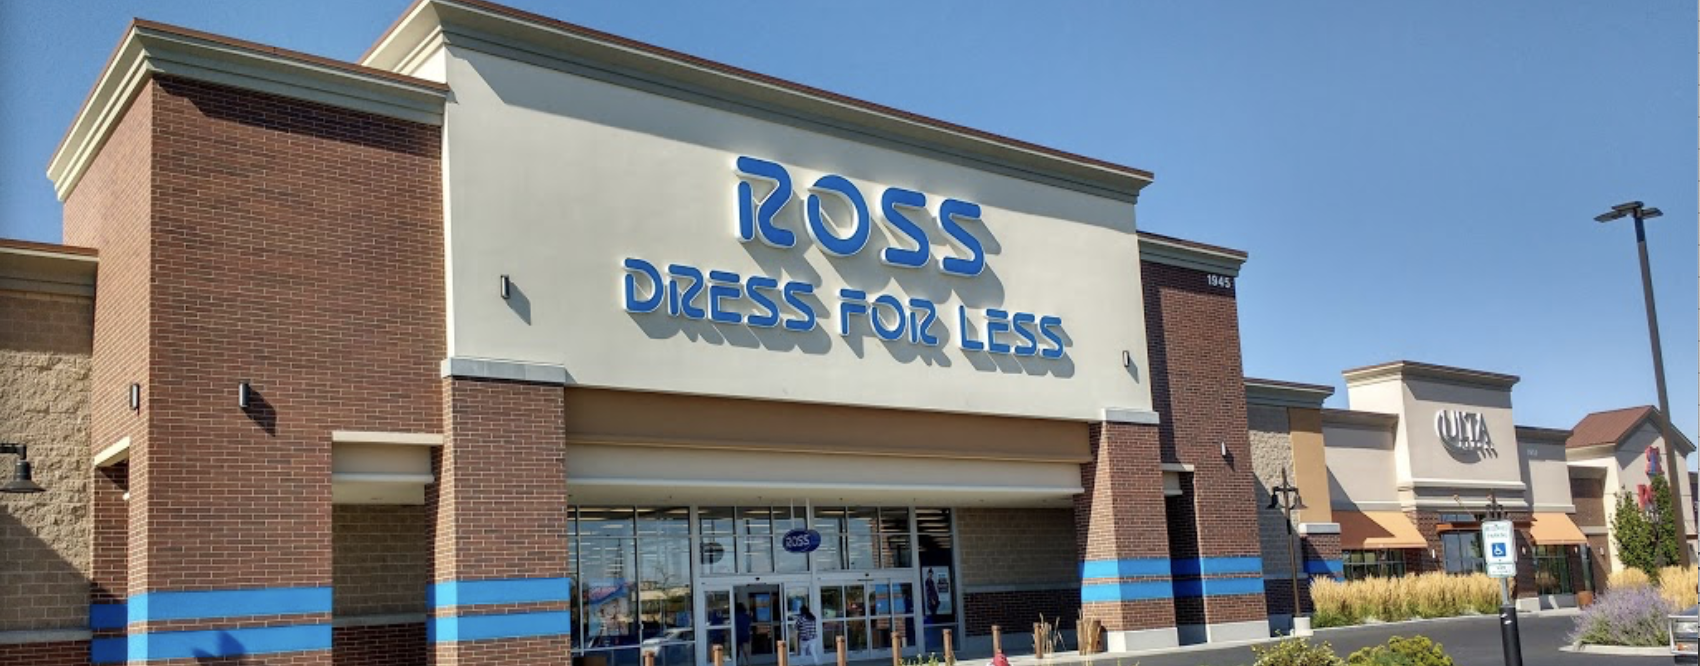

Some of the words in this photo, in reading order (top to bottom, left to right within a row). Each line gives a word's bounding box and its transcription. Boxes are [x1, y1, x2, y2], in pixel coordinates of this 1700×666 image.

[735, 155, 986, 277] ROSS
[1207, 273, 1231, 288] 1945
[624, 257, 817, 332] DRESS
[839, 288, 939, 346] FOR
[958, 304, 1065, 360] LESS
[1440, 410, 1489, 441] ULTA
[785, 533, 810, 548] ROSS
